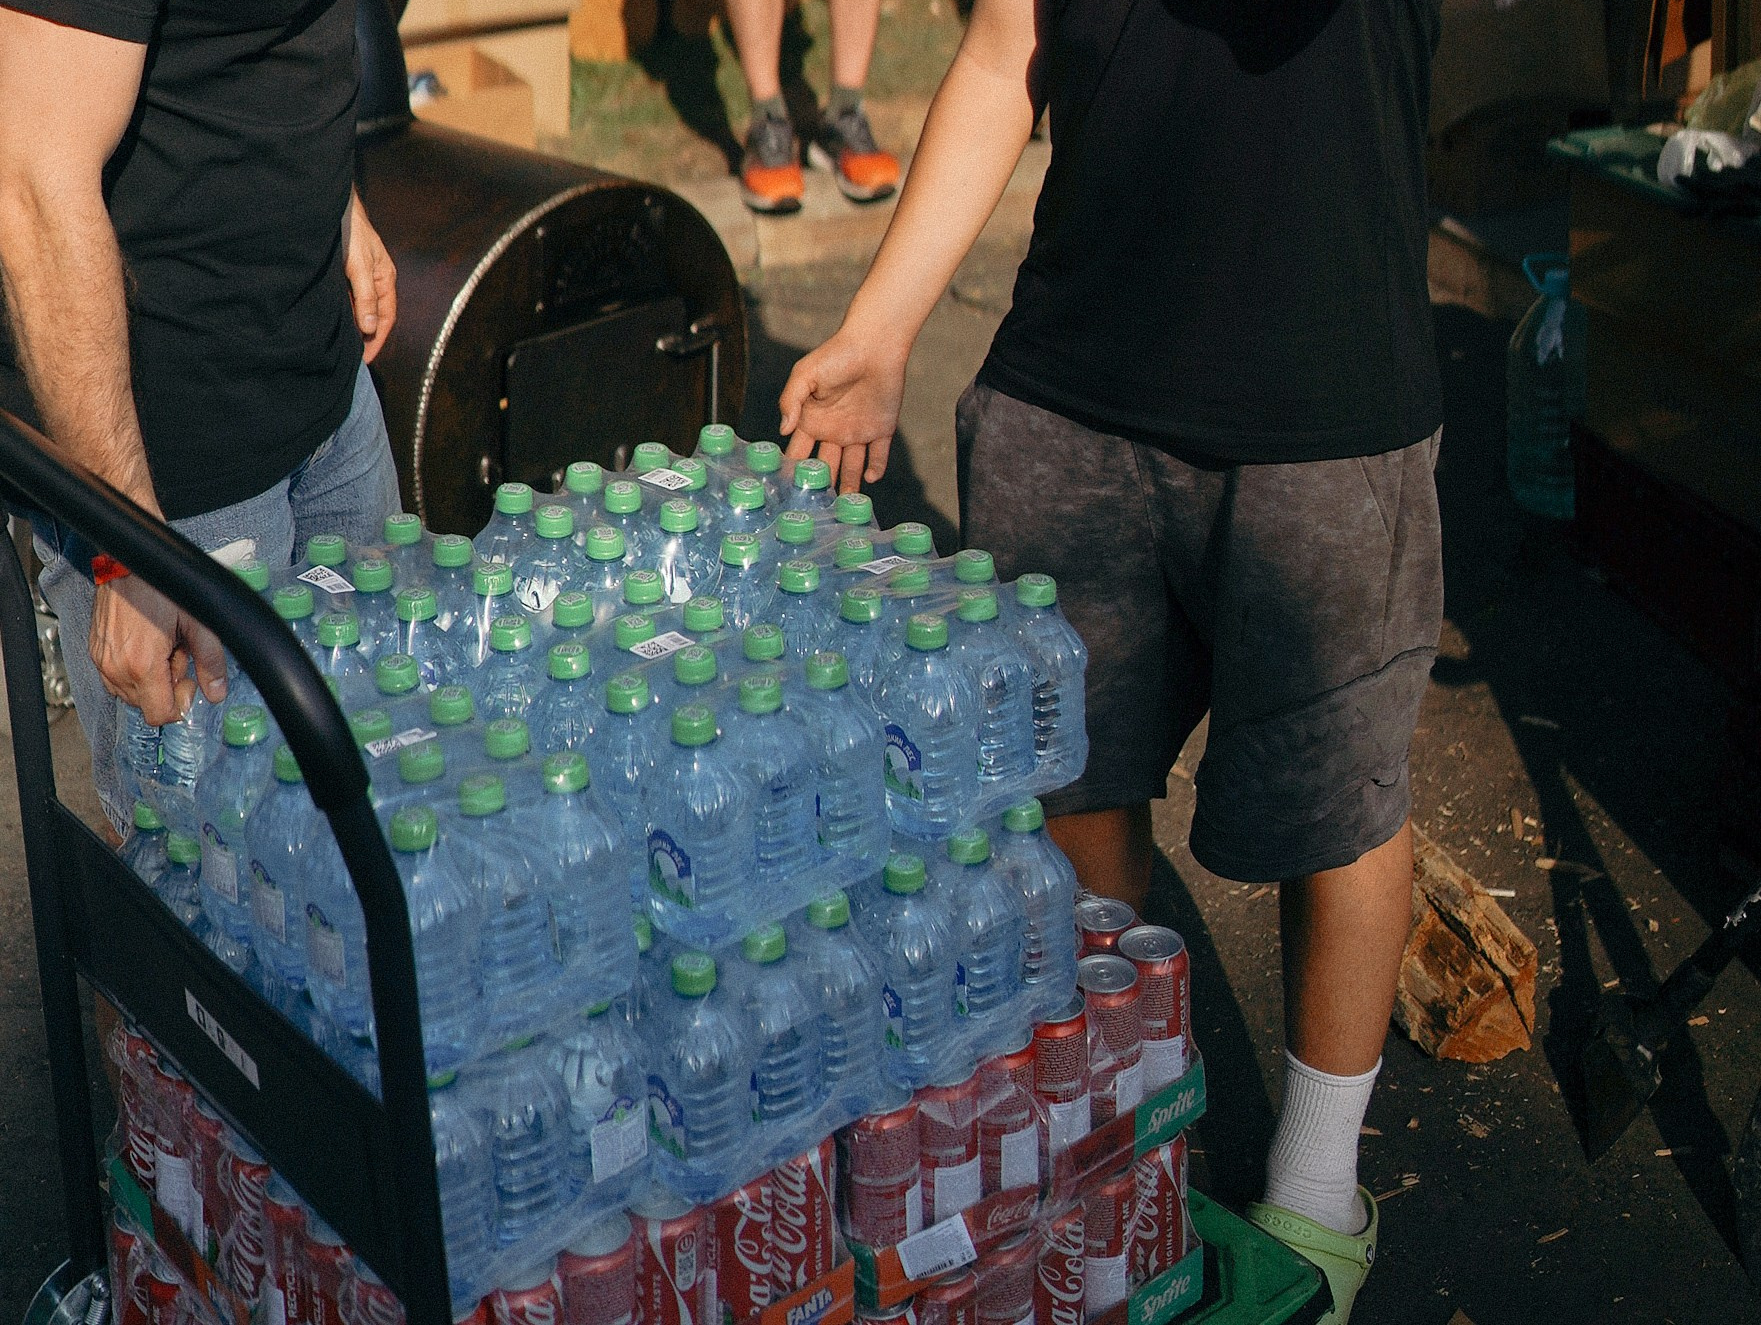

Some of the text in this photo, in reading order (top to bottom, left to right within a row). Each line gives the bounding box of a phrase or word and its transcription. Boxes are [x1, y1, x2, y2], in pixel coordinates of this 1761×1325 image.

[1148, 1088, 1195, 1133] Sprite
[1165, 1190, 1173, 1268] RIGINAL TASTE
[1263, 1213, 1312, 1239] crocs
[1037, 1219, 1085, 1325] a-Cola
[787, 1287, 833, 1325] FANTA
[1141, 1275, 1191, 1322] Sprite
